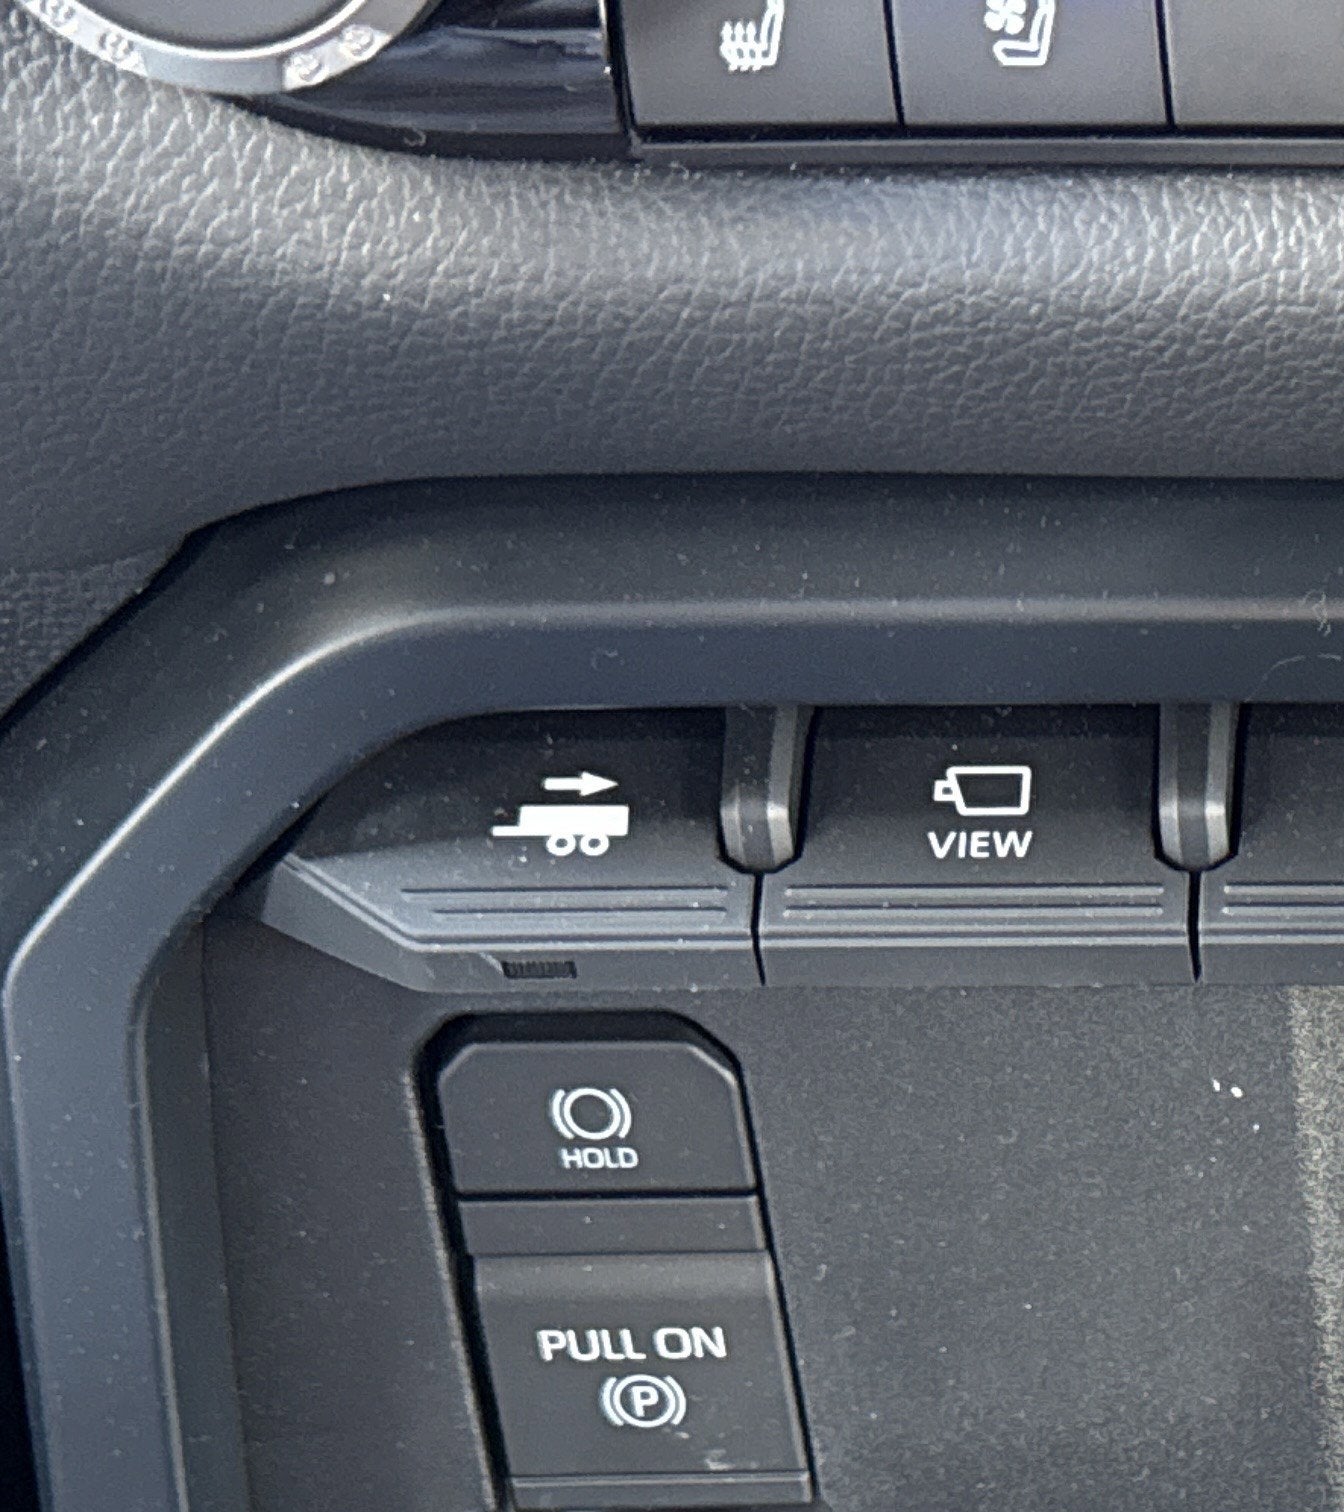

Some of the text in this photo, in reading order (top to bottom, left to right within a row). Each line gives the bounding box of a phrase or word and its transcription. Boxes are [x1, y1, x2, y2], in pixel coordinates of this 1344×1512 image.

[927, 830, 1033, 859] VIEW
[560, 1147, 638, 1169] HOLD
[536, 1325, 727, 1362] PULL ON
